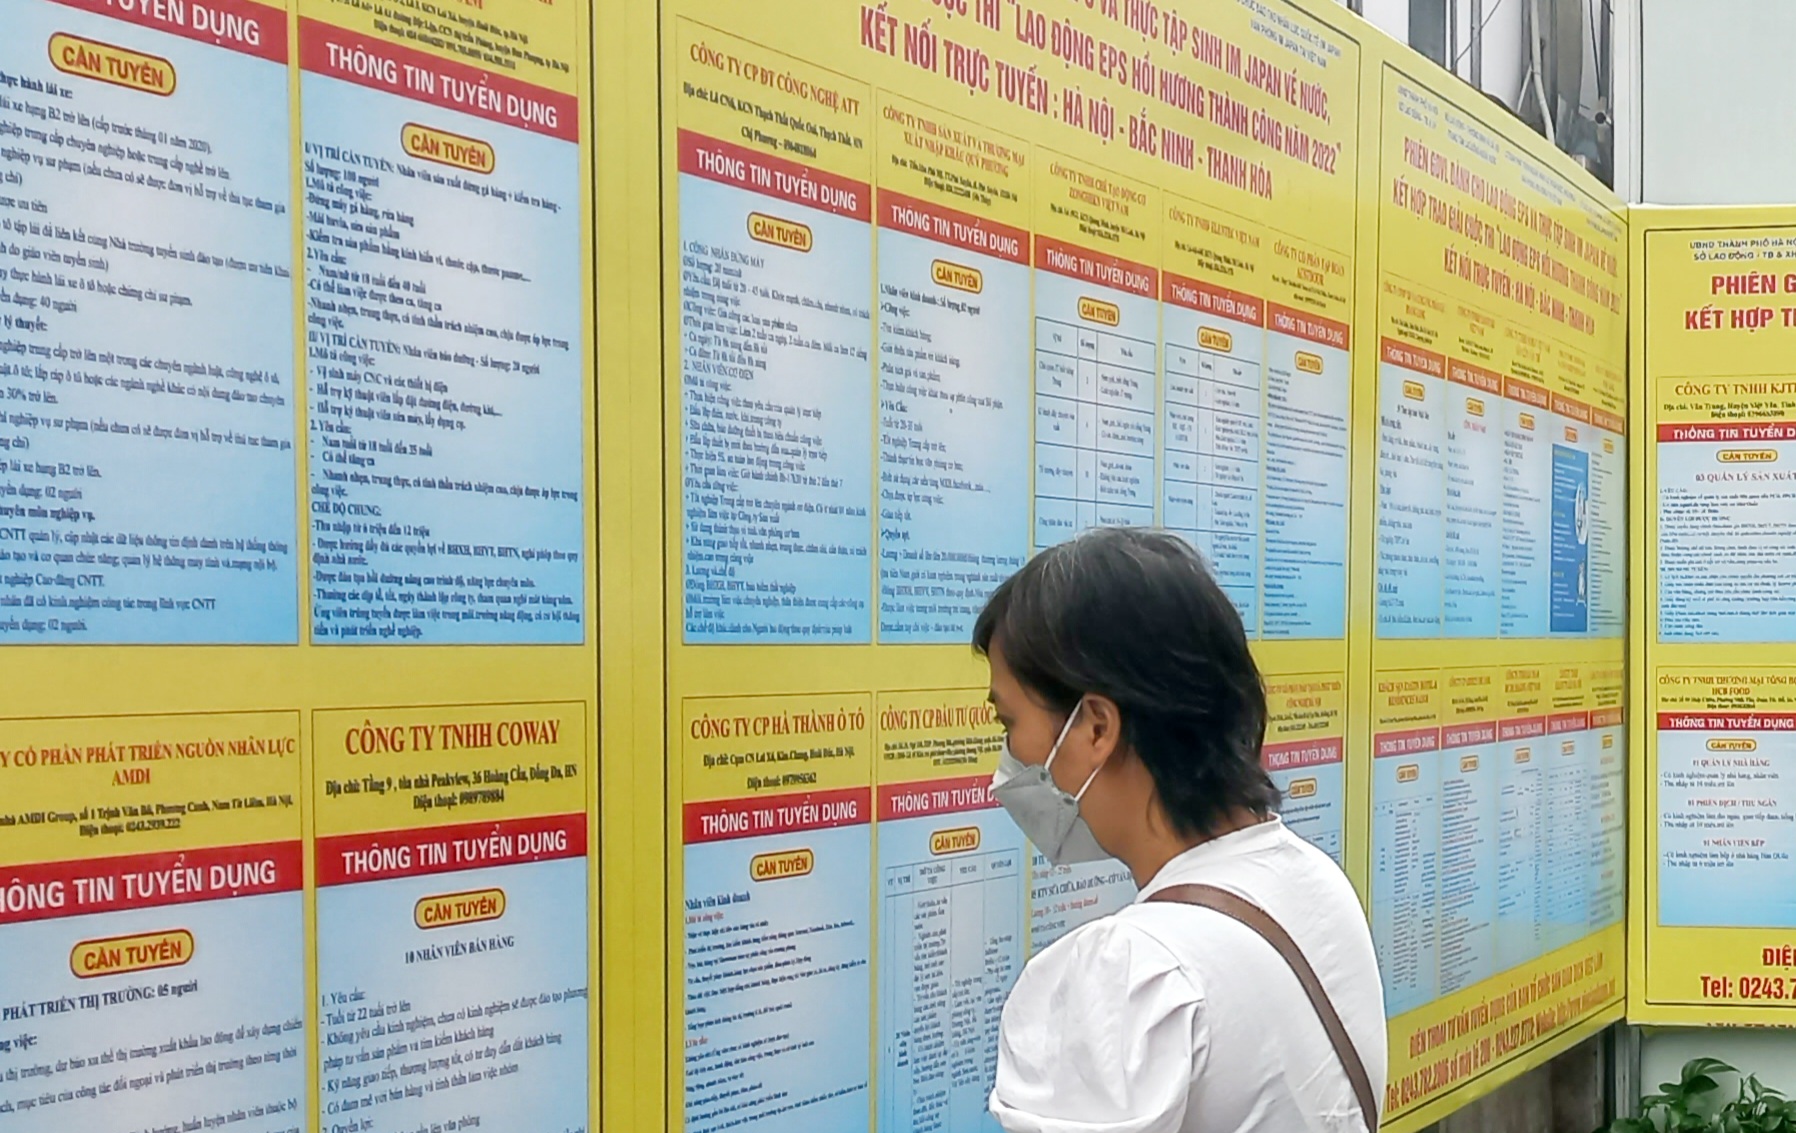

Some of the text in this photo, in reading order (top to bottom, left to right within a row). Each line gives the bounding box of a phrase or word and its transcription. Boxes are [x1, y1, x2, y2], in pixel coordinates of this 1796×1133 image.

[861, 1, 1273, 201] KẾT NỐI TRỰC TUYẾN HÀ NỘI BẮC NINH THANH HÓA
[1051, 17, 1094, 71] ĐỘNG
[1099, 41, 1127, 85] EPS
[1160, 68, 1205, 118] HƯƠNG
[1208, 90, 1249, 137] THÀNH
[1252, 108, 1282, 152] CÔNG
[1285, 124, 1309, 164] NĂM
[1711, 271, 1776, 295] PHIÊN
[1685, 304, 1725, 330] KẾT
[1731, 307, 1774, 333] HỢP
[345, 719, 560, 755] CÔNG TY TNHH COWAY
[691, 713, 730, 739] CÔNG
[734, 717, 750, 737] TY
[754, 717, 770, 736] CP
[793, 709, 835, 733] THÀNH
[342, 824, 567, 875] THÔNG TIN TUYỂN DỤNG
[1701, 976, 1733, 998] Tel:
